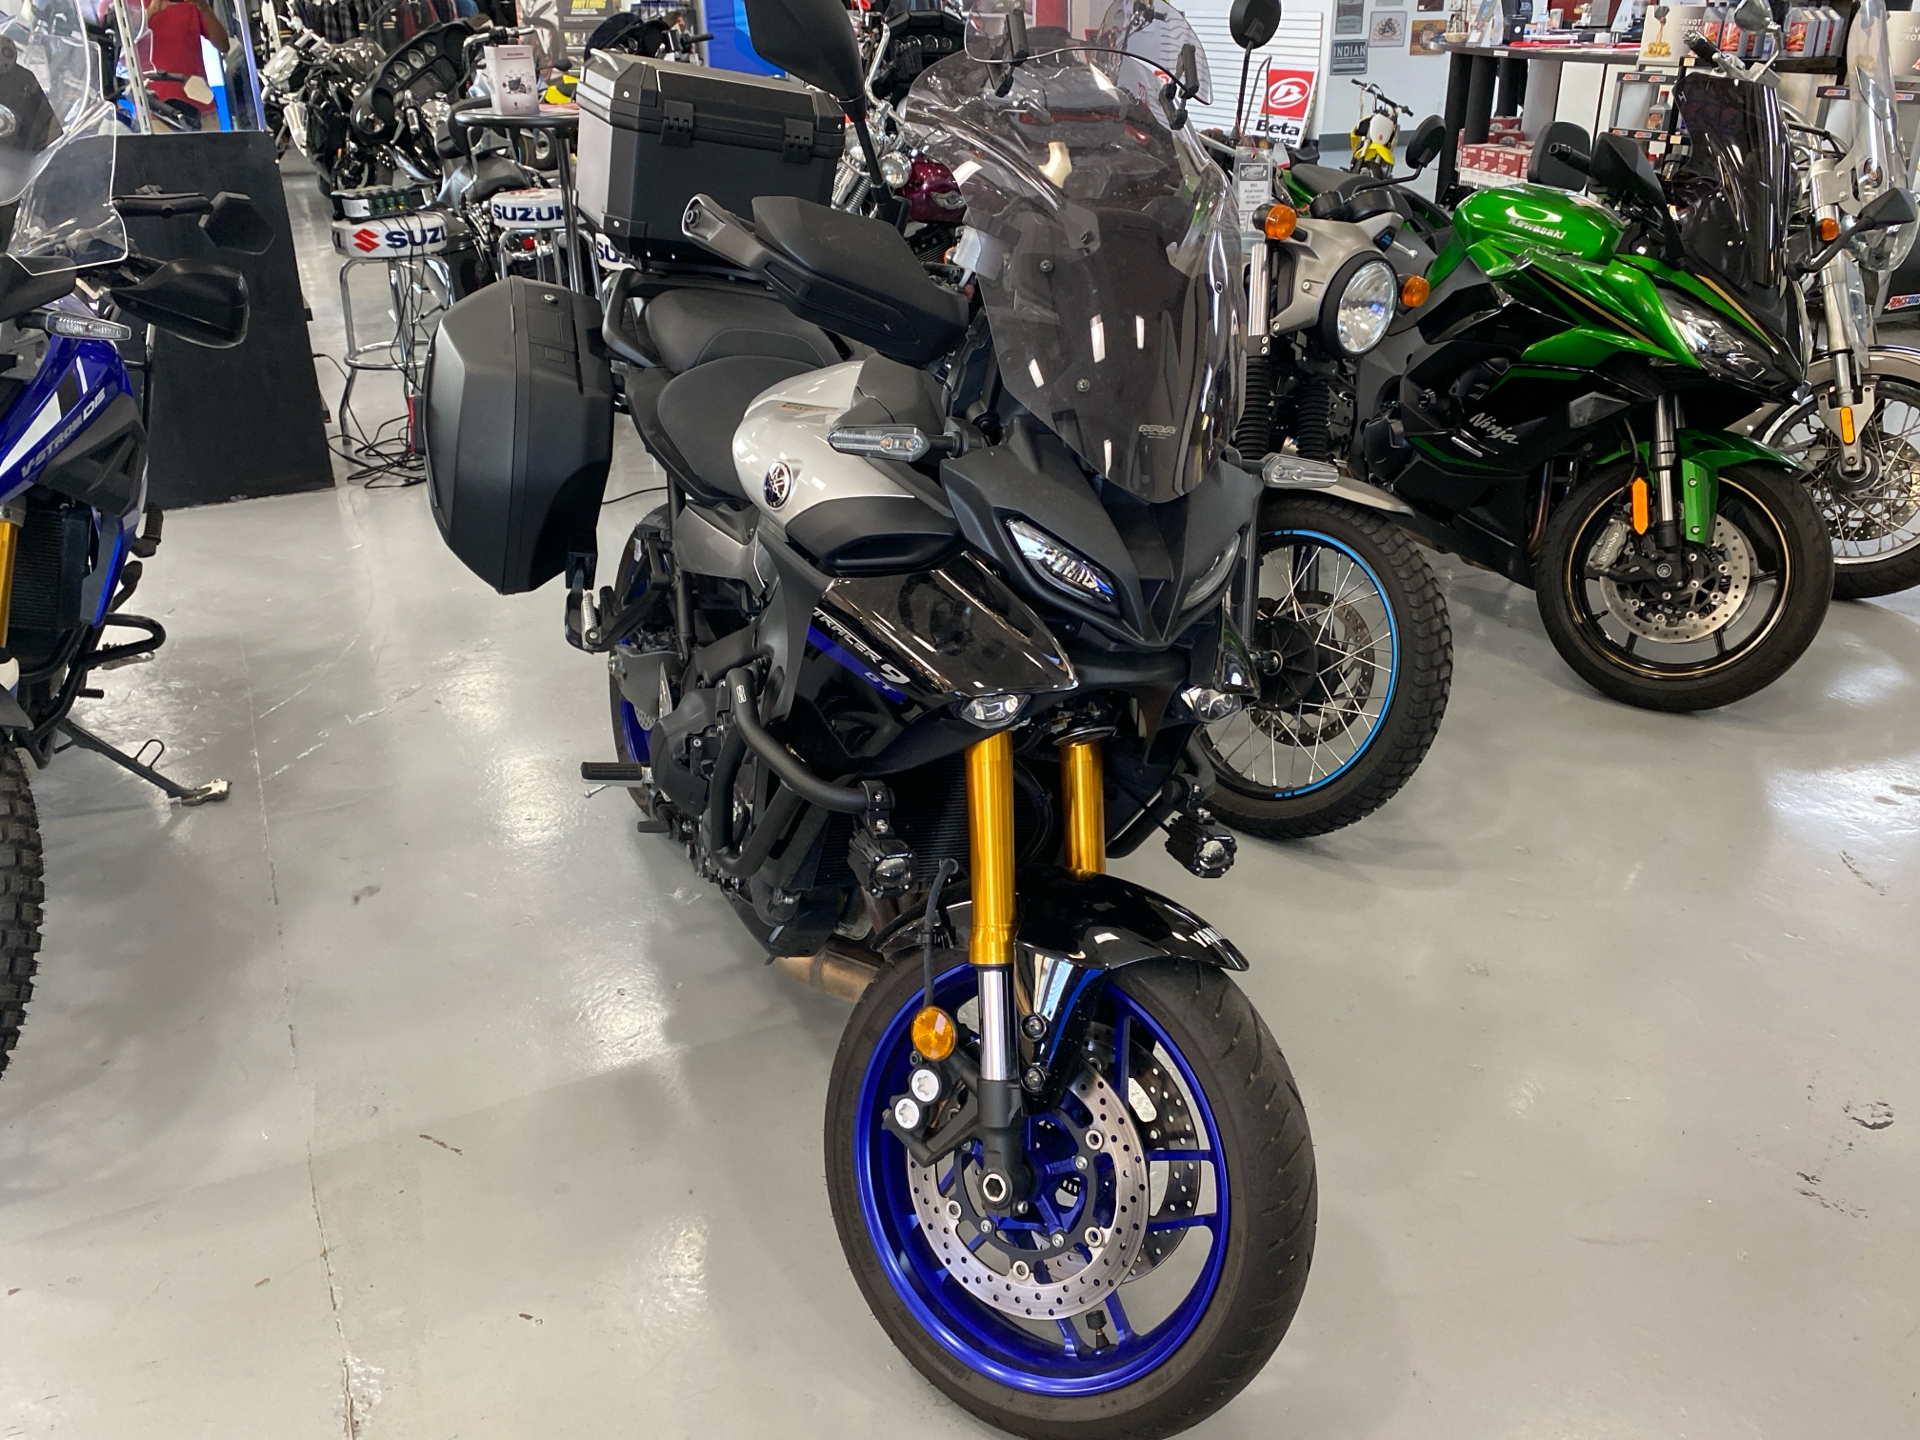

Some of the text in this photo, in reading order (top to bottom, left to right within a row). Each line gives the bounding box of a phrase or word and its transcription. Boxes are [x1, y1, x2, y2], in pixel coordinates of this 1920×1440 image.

[1333, 45, 1366, 58] INDIAN
[1256, 119, 1300, 137] Beta
[1508, 215, 1568, 240] Kawasaki
[21, 387, 106, 479] V-STROM DE
[1469, 412, 1520, 446] Ninja
[1598, 531, 1620, 562] brembo
[812, 606, 911, 685] TRACER 9
[864, 671, 898, 693] GT
